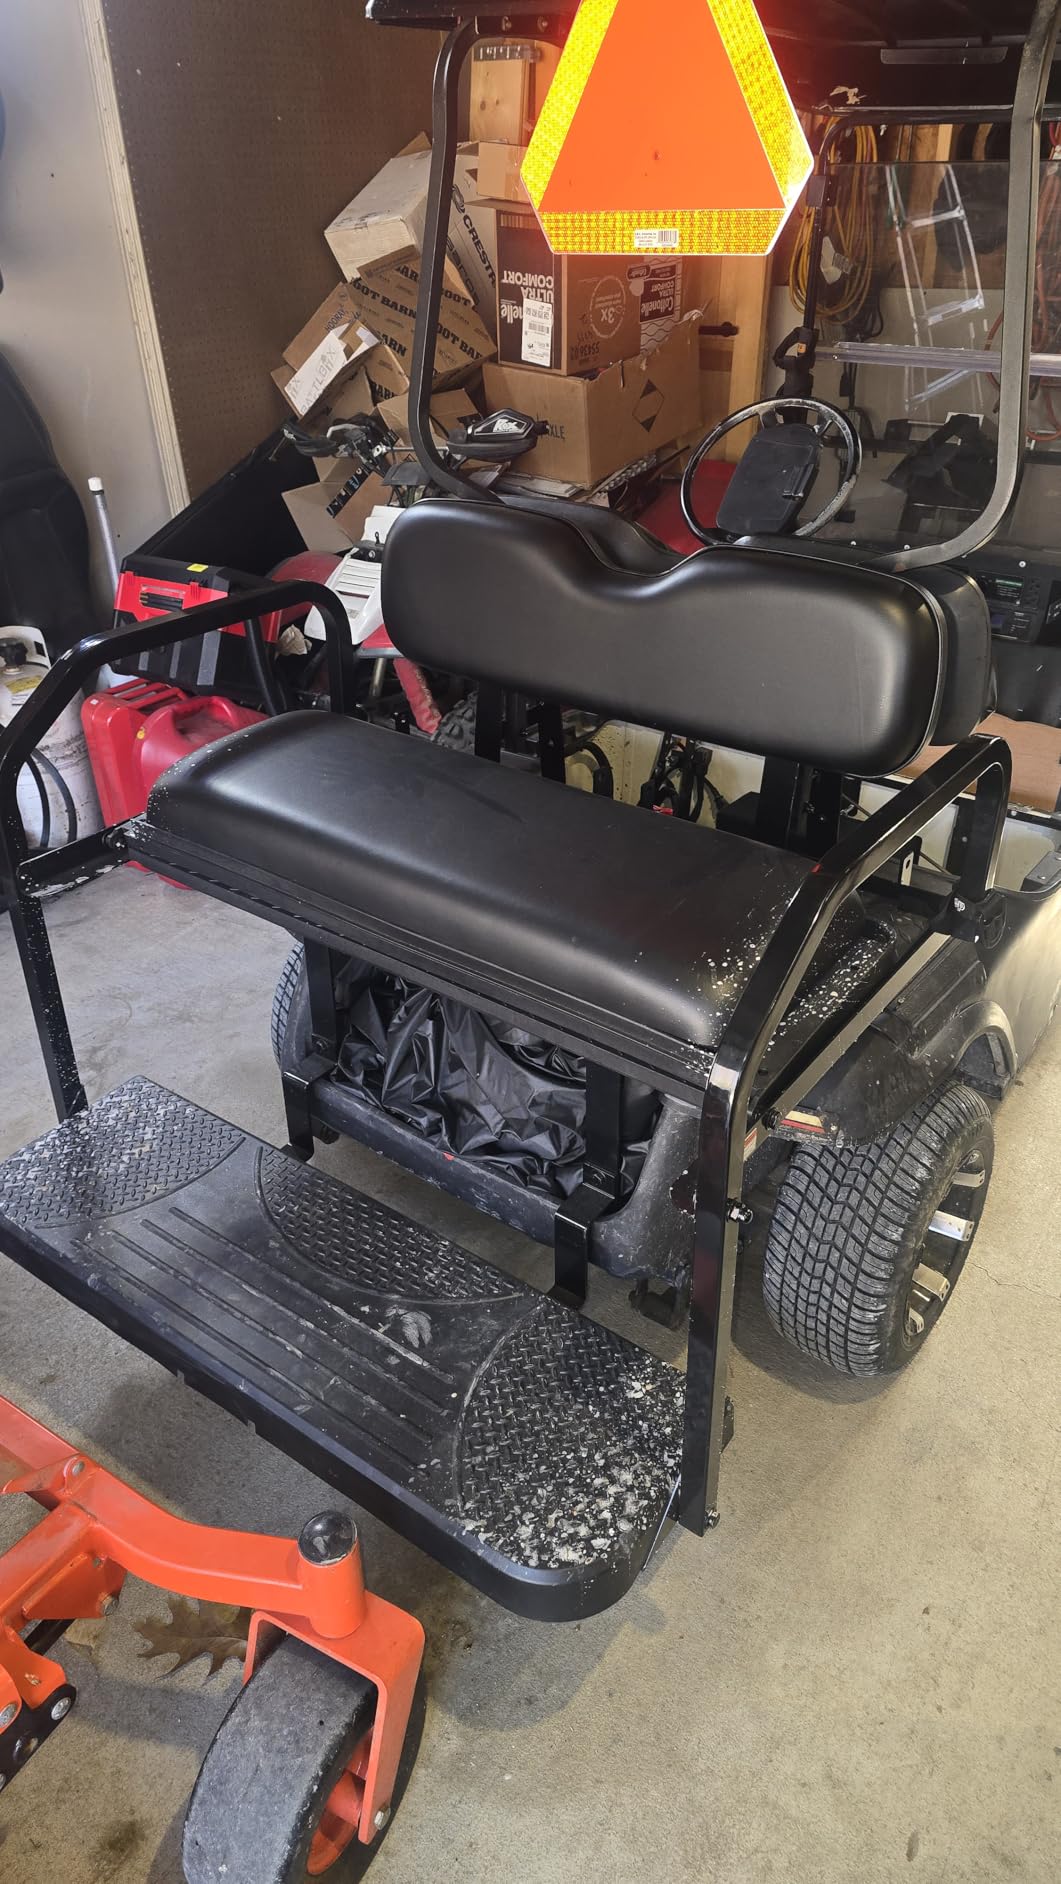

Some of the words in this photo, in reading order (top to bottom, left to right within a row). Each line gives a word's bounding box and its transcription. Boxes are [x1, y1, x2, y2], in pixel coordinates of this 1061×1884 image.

[463, 214, 496, 288] CRESTR
[502, 270, 554, 288] COMFORT
[521, 286, 554, 303] ULTRA
[380, 296, 416, 319] BARN
[600, 307, 615, 323] 3x
[380, 332, 407, 358] ARN
